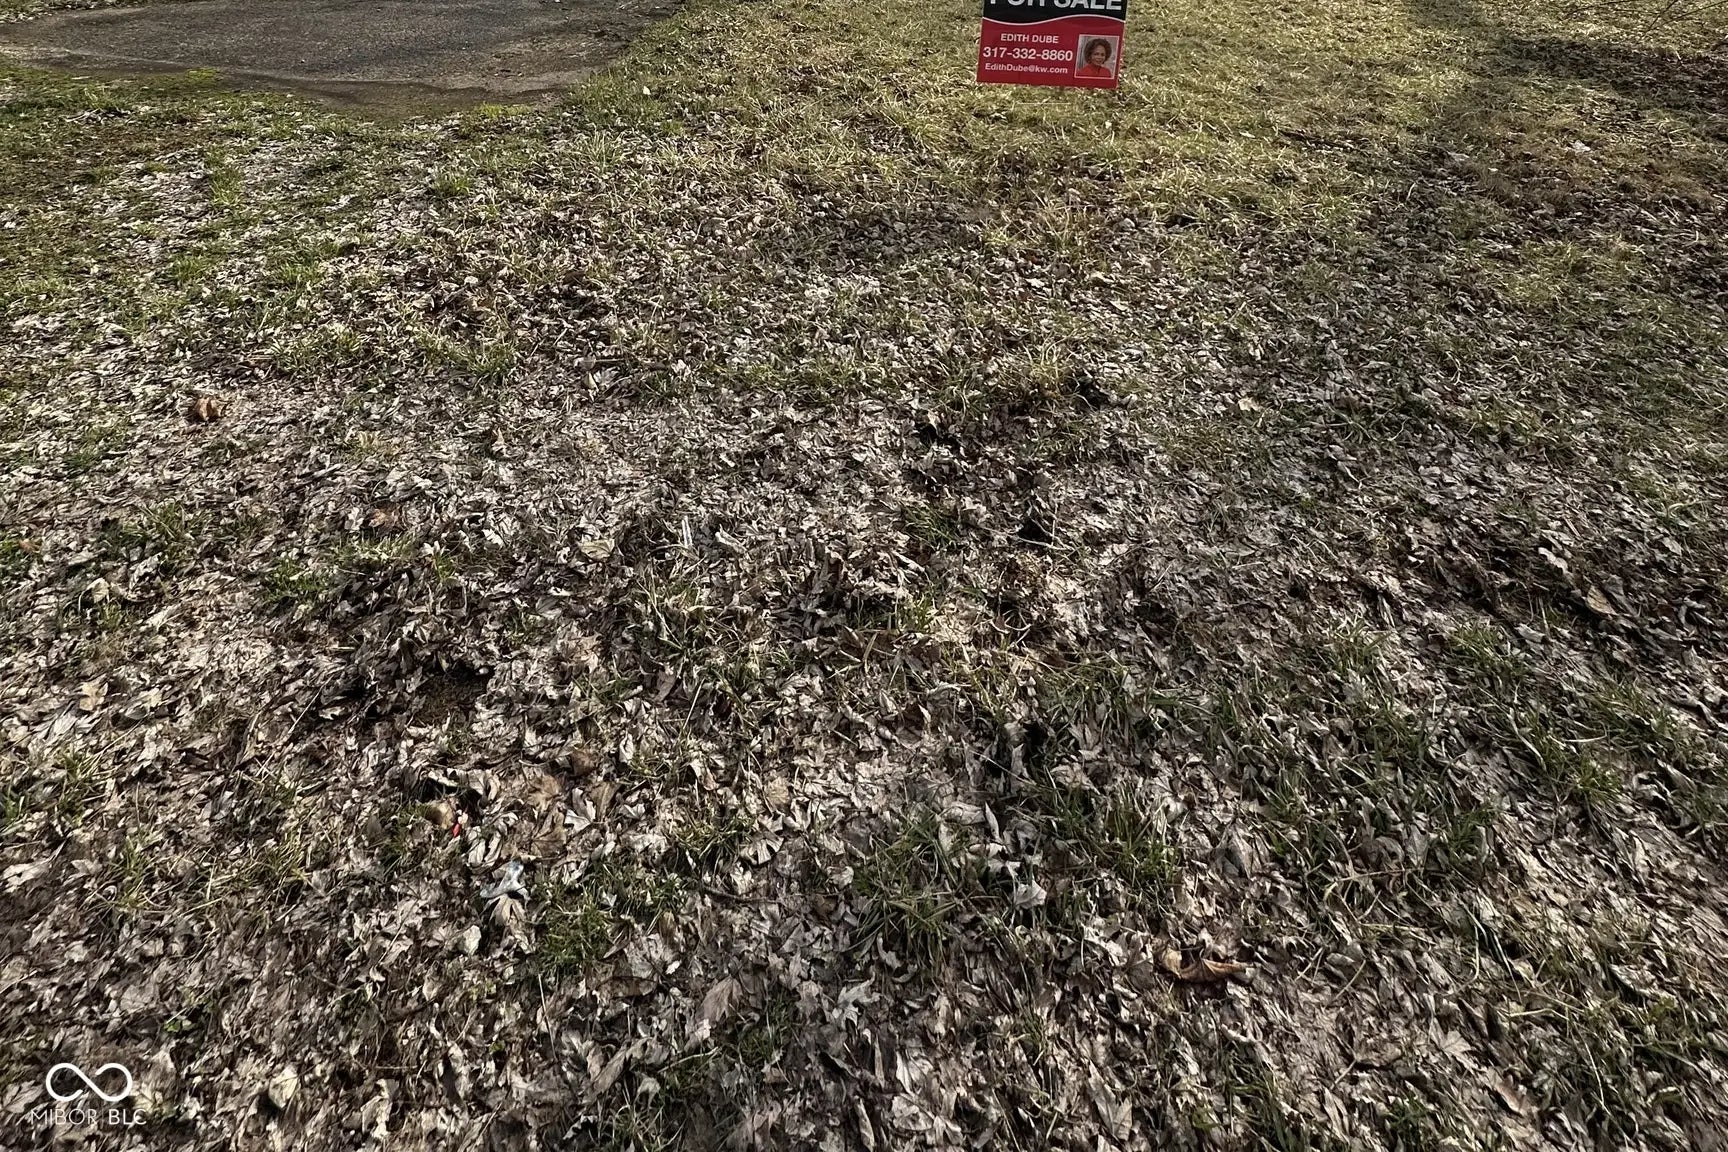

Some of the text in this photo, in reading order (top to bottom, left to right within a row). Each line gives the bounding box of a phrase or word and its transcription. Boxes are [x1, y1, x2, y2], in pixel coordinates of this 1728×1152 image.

[1000, 33, 1060, 44] EDITH DUBE
[983, 46, 1073, 61] 317-332-8860
[984, 62, 1068, 74] EdithDube@kw.com
